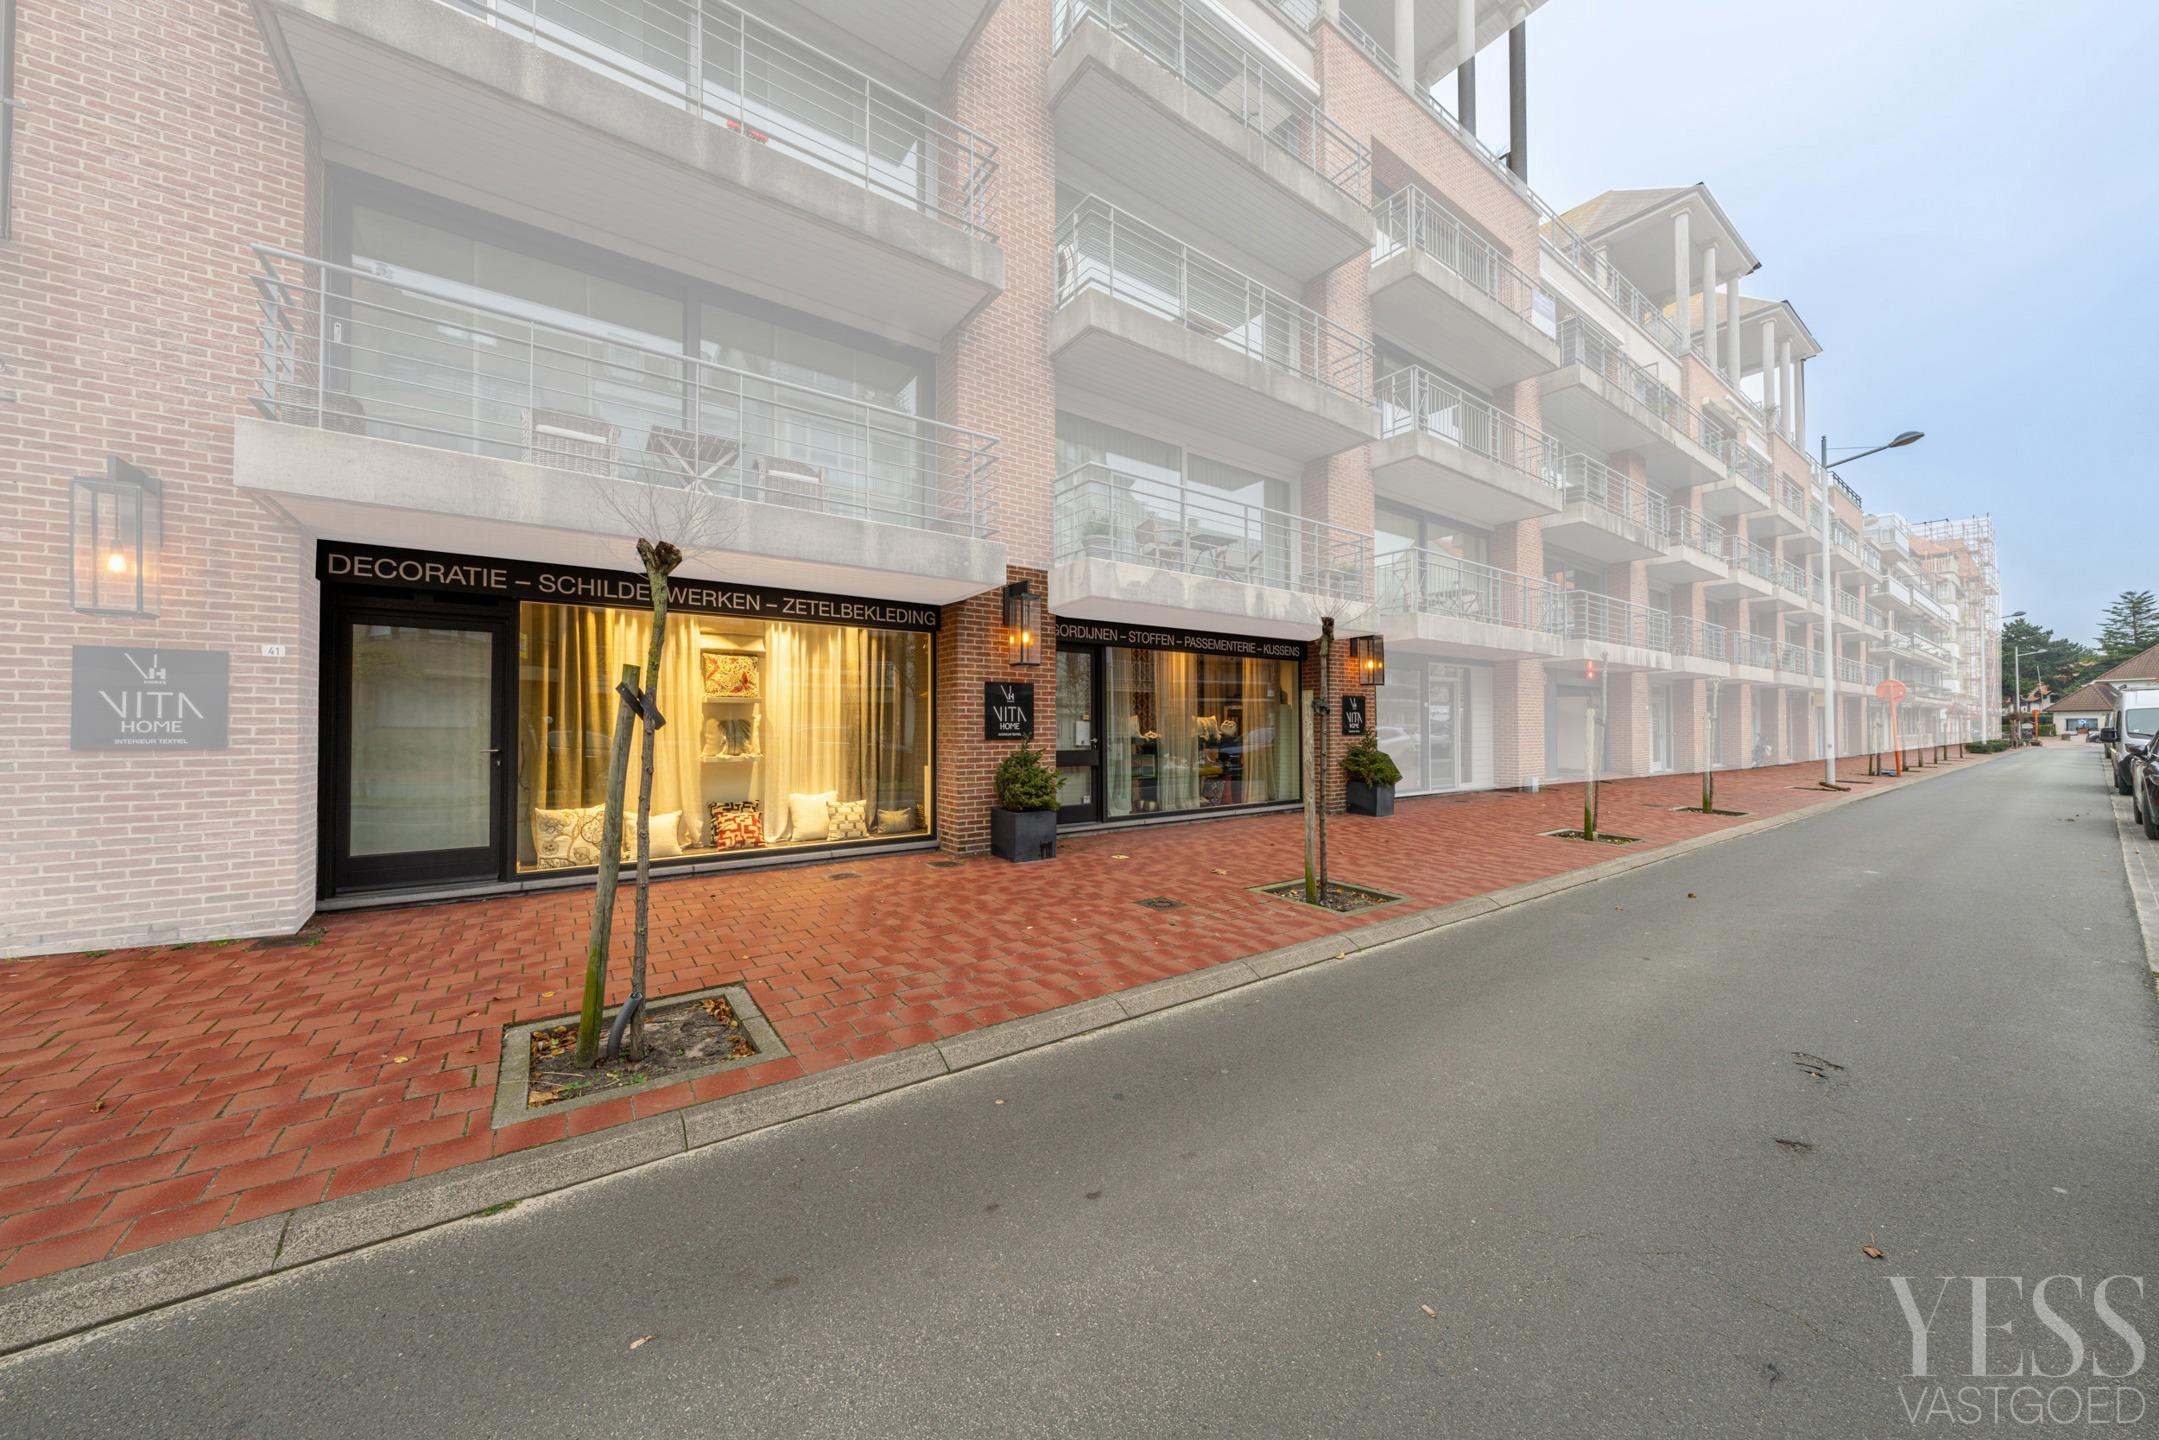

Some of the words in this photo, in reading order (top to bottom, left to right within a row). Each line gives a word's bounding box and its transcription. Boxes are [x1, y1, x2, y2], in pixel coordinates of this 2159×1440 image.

[328, 553, 508, 589] DECORATIE
[538, 573, 761, 611] SCHILDEWERKEN
[782, 597, 937, 626] ZETELBEKLEDING
[1128, 631, 1175, 647] STOFFEN
[1184, 636, 1256, 653] PASSEMENTERIE
[1263, 644, 1300, 657] KUSSENS
[267, 647, 280, 656] 41
[99, 690, 204, 720] VITA
[993, 706, 1027, 722] VITA
[1346, 711, 1363, 723] VITA
[121, 720, 183, 733] HOME
[1000, 722, 1021, 730] HOME
